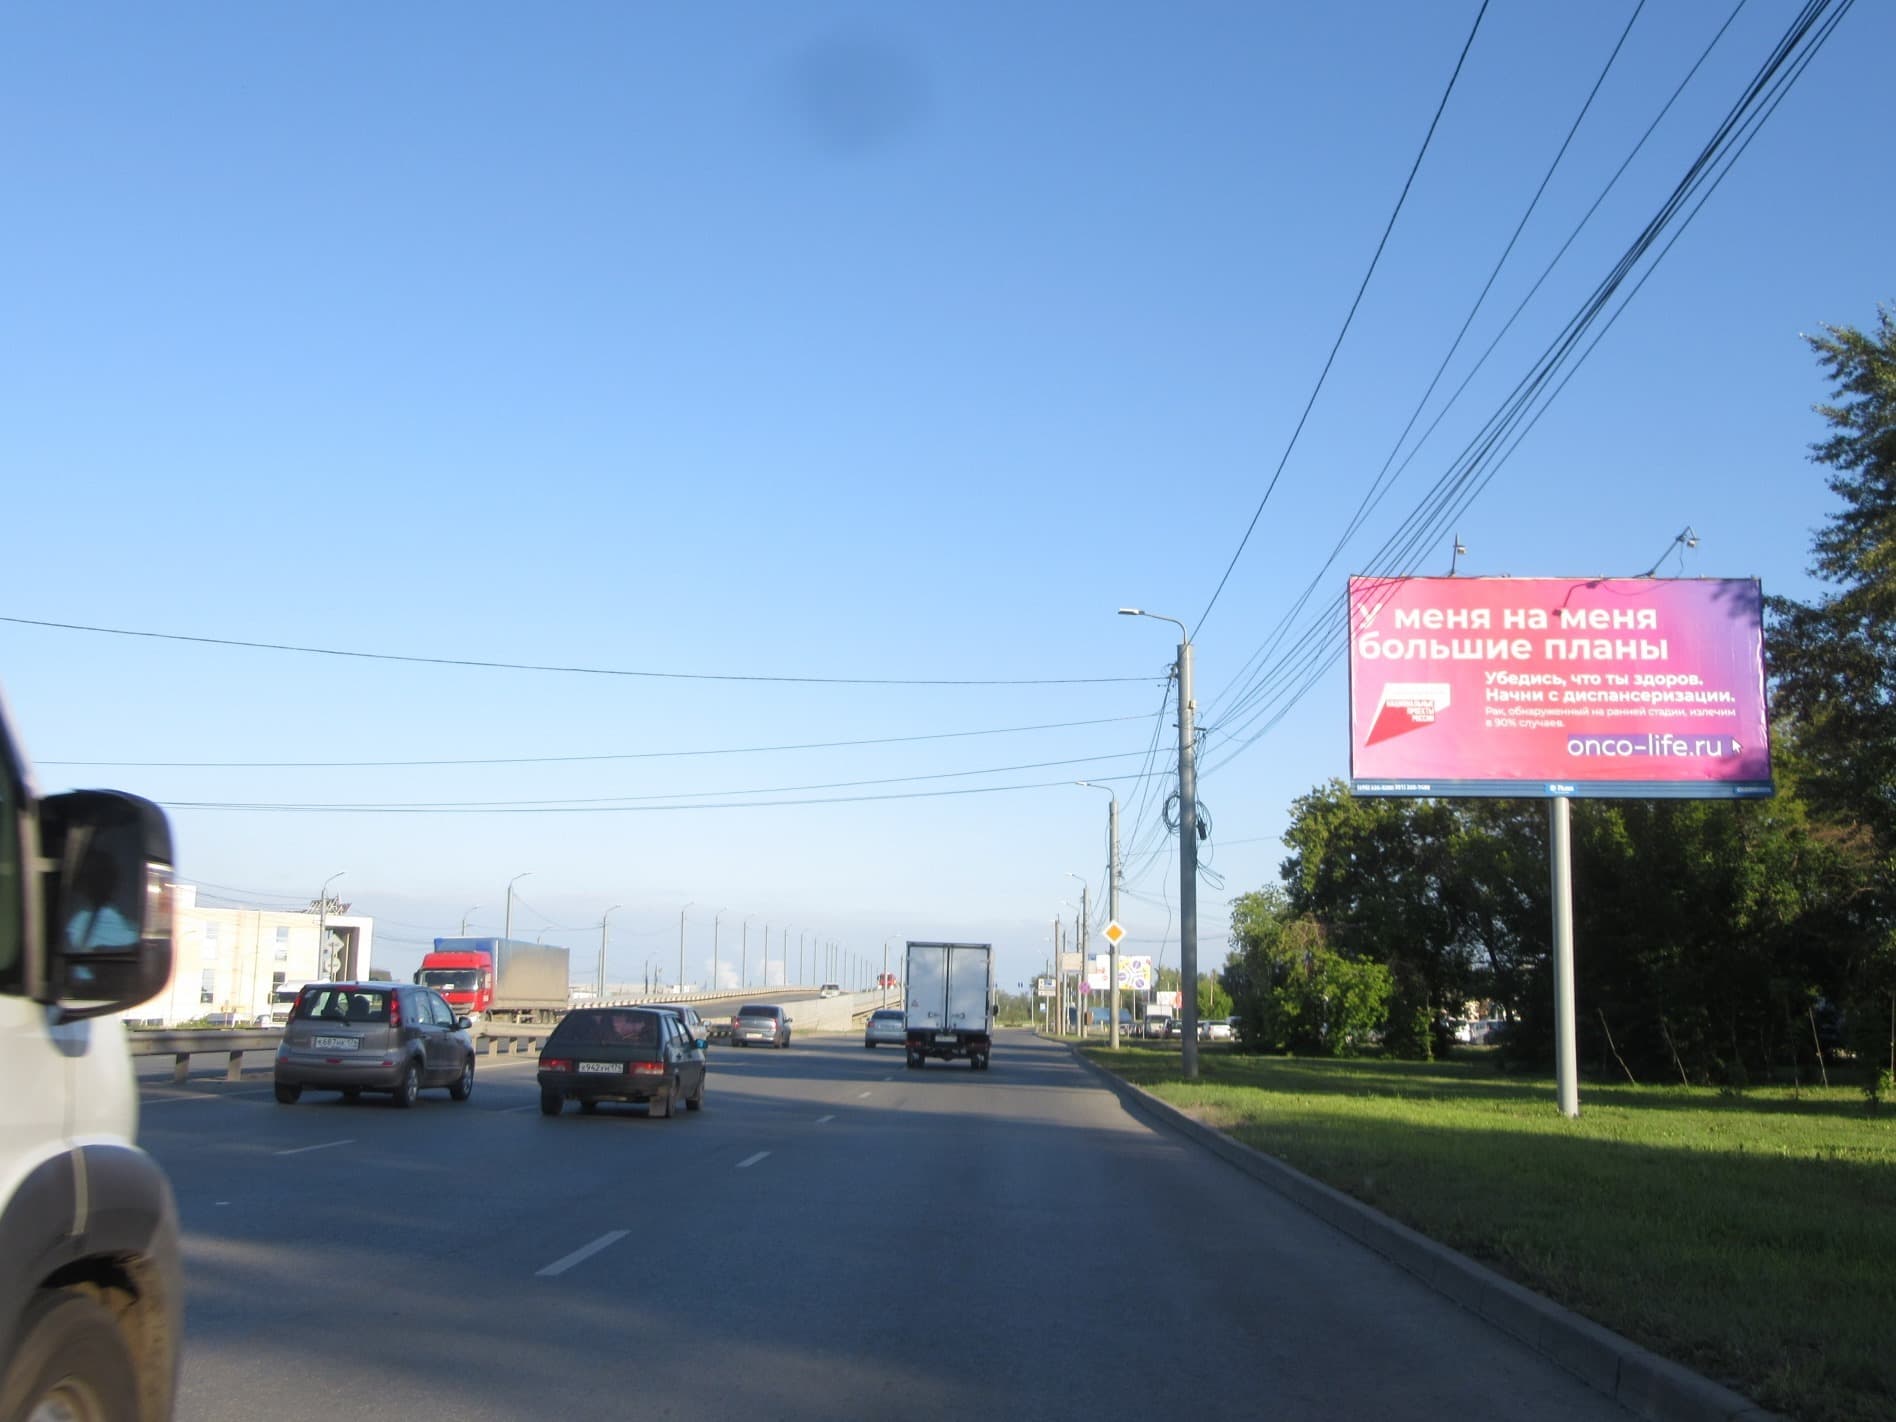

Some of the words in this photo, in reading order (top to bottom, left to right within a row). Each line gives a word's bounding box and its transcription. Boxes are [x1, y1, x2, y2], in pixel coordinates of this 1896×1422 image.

[1357, 602, 1383, 629] У
[1395, 608, 1490, 629] меня
[1504, 608, 1549, 629] на
[1560, 608, 1656, 629] меня
[1358, 631, 1532, 660] большие
[1545, 638, 1668, 660] планы
[1485, 671, 1566, 687] Убедись,
[1571, 673, 1601, 685] что
[1605, 673, 1629, 685] ты
[1634, 673, 1703, 687] здоров.
[1485, 688, 1543, 701] Начни
[1548, 690, 1558, 702] с
[1563, 690, 1736, 705] диспансеризации.
[1508, 705, 1590, 717] обнаруженный
[1591, 708, 1605, 716] на
[1606, 706, 1646, 717] ранней
[1690, 708, 1736, 716] излечим
[1494, 717, 1517, 727] 90%
[1519, 718, 1565, 729] случаев.
[1567, 733, 1722, 757] onco-life.ru
